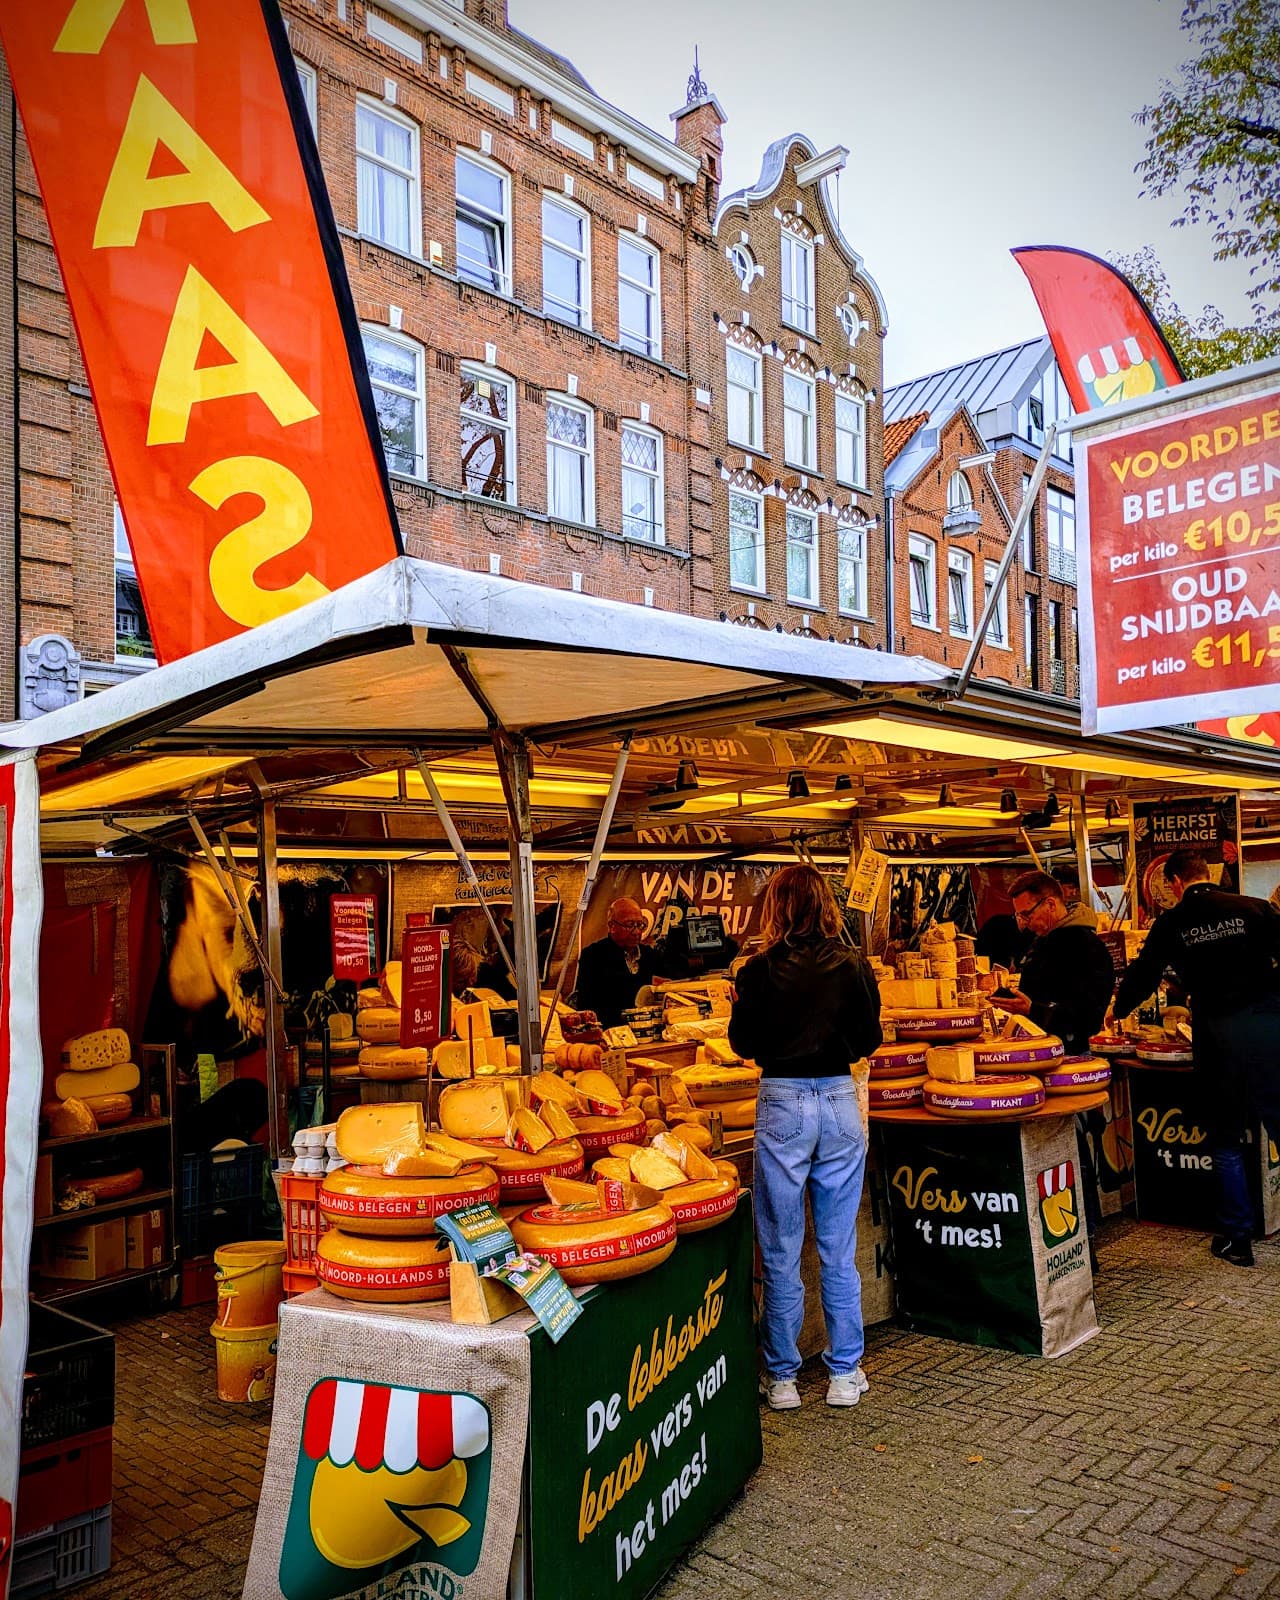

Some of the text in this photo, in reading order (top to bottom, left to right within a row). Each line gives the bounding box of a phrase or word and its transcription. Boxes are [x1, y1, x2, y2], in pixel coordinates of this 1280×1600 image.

[1110, 409, 1280, 484] VOORDEE
[1109, 549, 1139, 572] per
[1144, 541, 1178, 561] kilo
[1171, 566, 1247, 602] OUD
[1117, 662, 1147, 684] per
[1152, 656, 1186, 676] kilo
[1153, 813, 1216, 829] HERFST
[1153, 829, 1217, 842] MELANGE
[641, 871, 735, 903] VAN DE
[337, 916, 363, 925] Belegen
[342, 954, 364, 967] 10,50
[410, 953, 438, 964] HOLLANDS
[413, 963, 435, 974] BELEGEN
[414, 1007, 432, 1024] 8,50
[951, 1018, 975, 1027] PIKANT
[979, 1053, 1011, 1063] PIKANT
[991, 1097, 1023, 1108] PIKANT
[1136, 1107, 1208, 1145] Vers
[601, 1131, 634, 1145] BELEGEN
[891, 1165, 1020, 1213] Vers van
[358, 1202, 411, 1213] BELEGEN
[915, 1218, 1003, 1249] 't mes!
[561, 1244, 615, 1262] BELEGEN
[1047, 1242, 1083, 1272] HOLLAND
[327, 1267, 433, 1284] NOORD-HOLLANDS
[586, 1268, 727, 1455] De lekkerste
[577, 1353, 727, 1543] kaas vers van
[615, 1431, 708, 1583] het mes!
